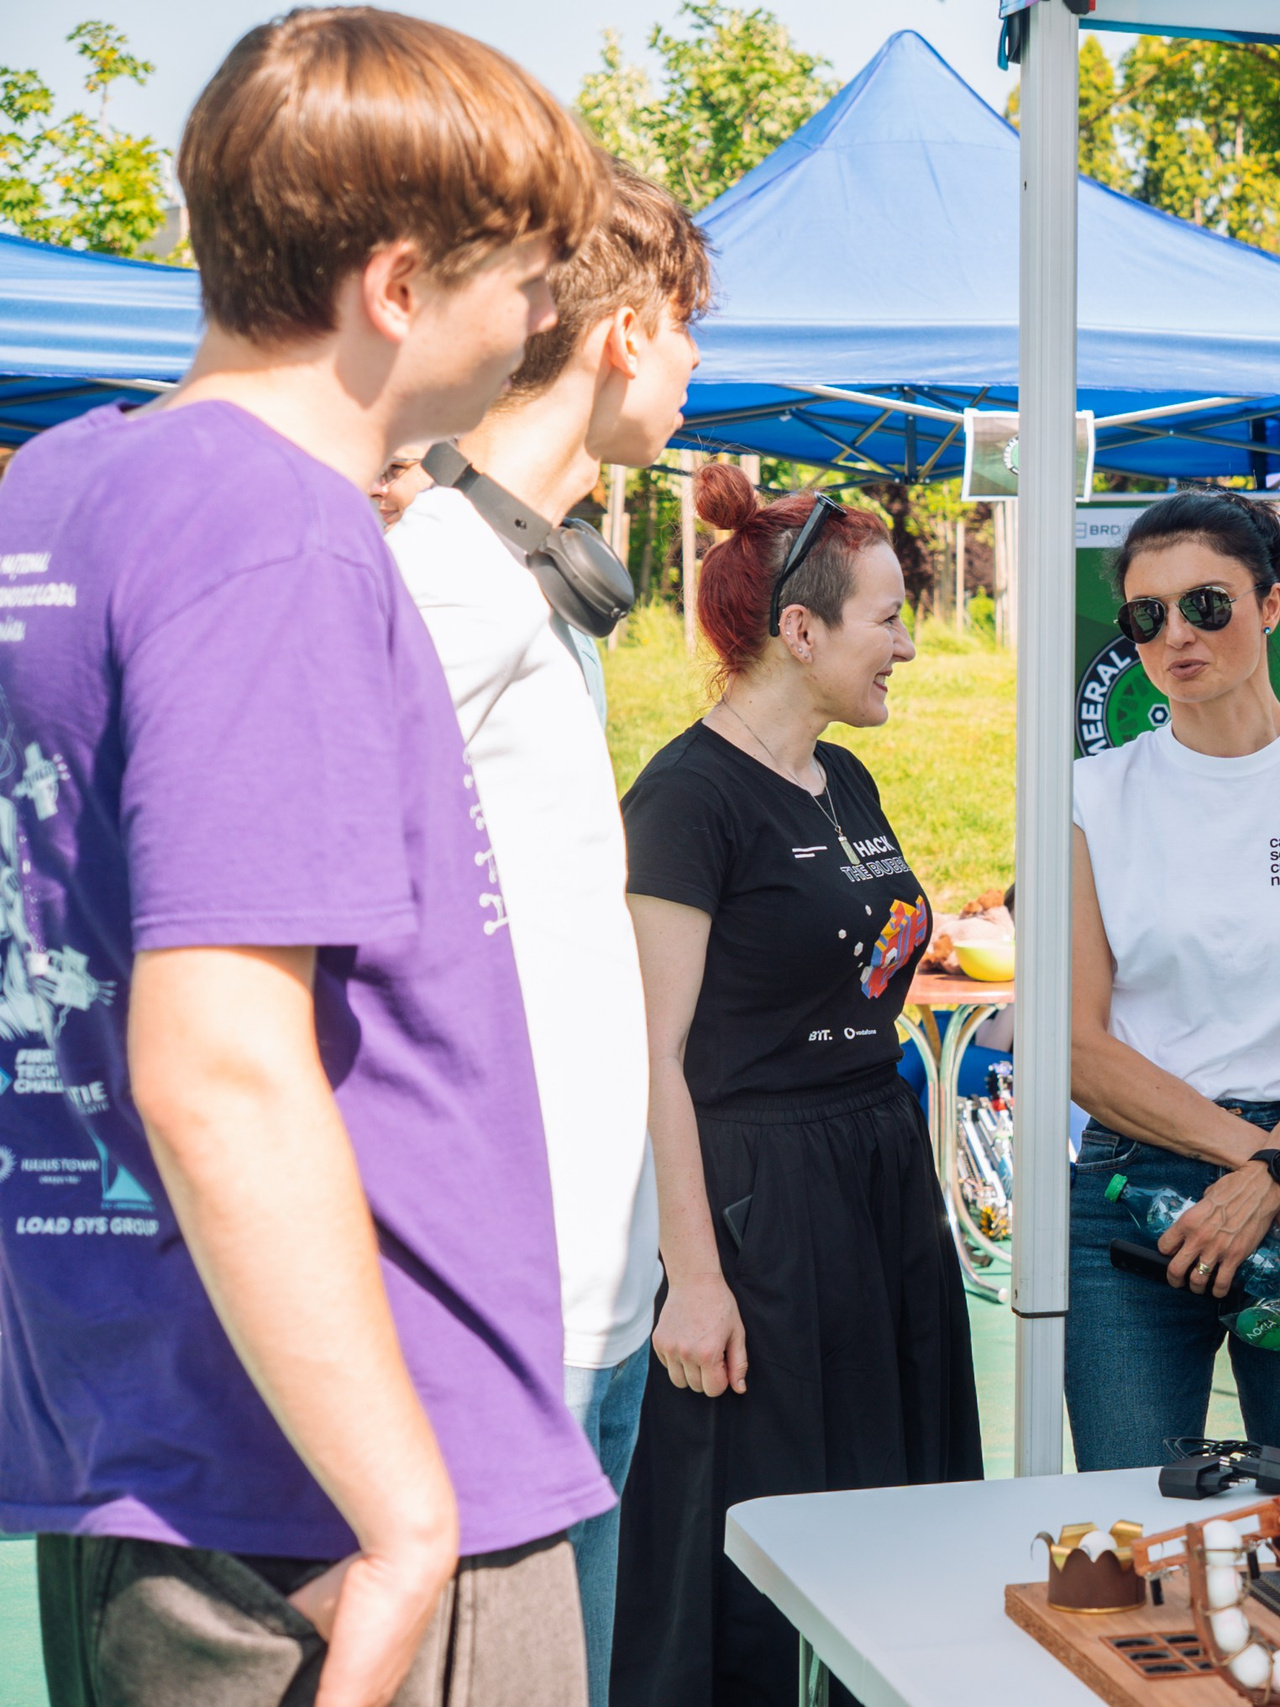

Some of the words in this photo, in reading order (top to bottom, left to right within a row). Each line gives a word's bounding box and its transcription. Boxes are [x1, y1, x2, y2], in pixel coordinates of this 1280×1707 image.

[1090, 525, 1120, 536] BRD
[853, 836, 896, 858] HACK
[840, 864, 874, 883] THE
[16, 1216, 71, 1235] LOAD
[72, 1216, 109, 1235] SYS
[110, 1217, 159, 1236] GROUP
